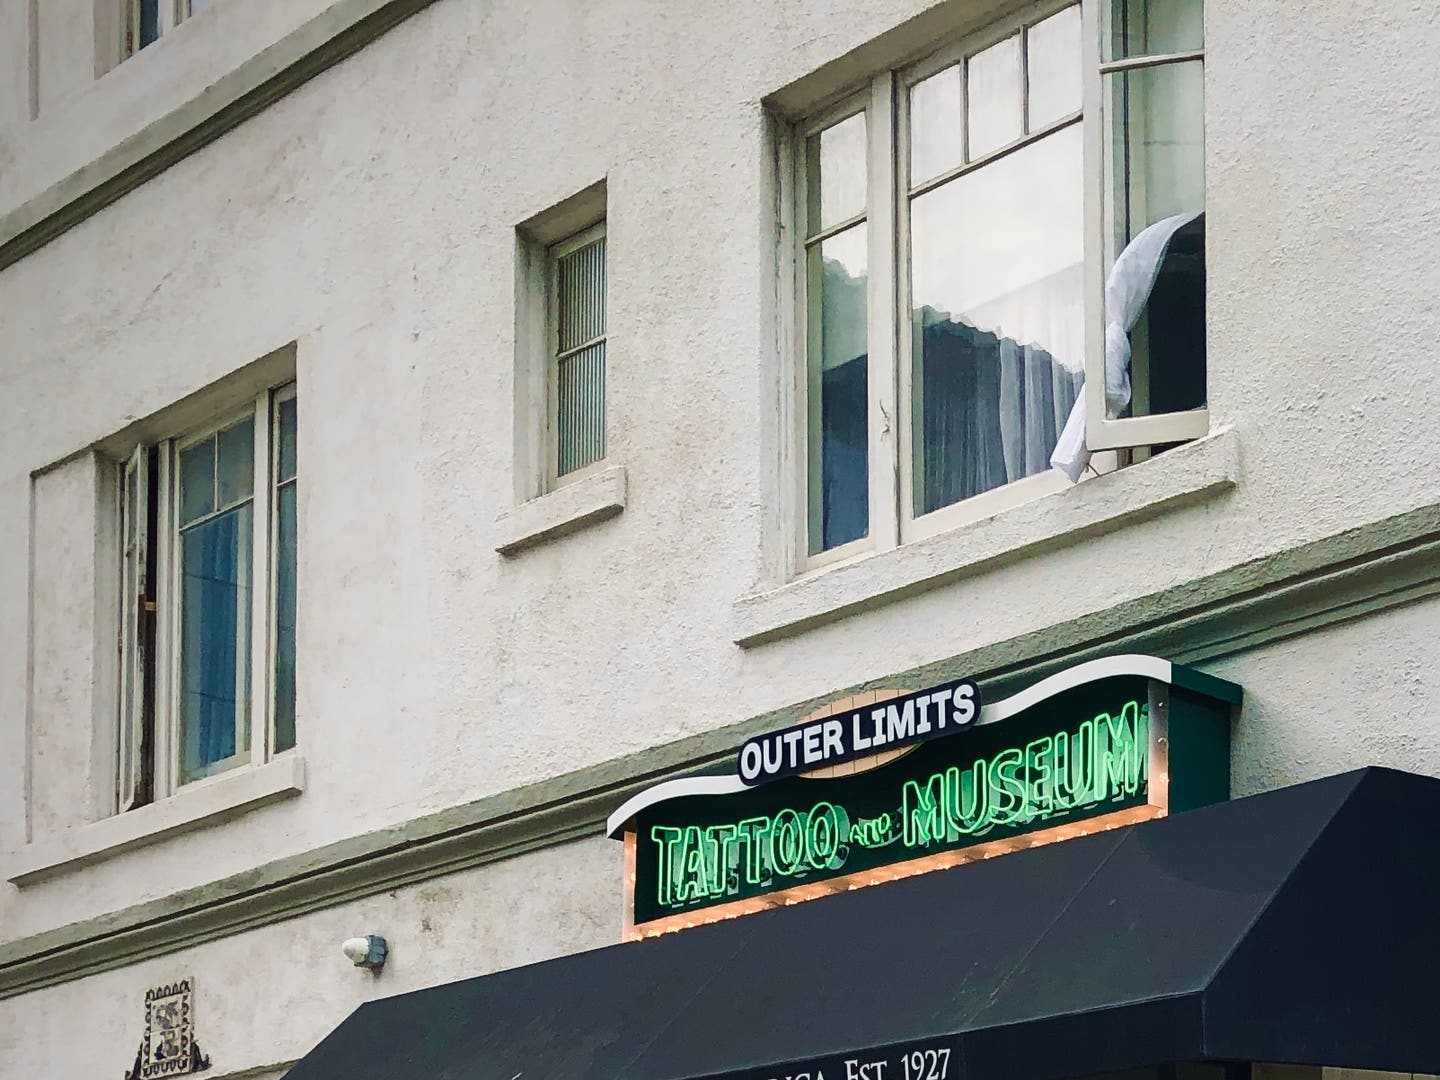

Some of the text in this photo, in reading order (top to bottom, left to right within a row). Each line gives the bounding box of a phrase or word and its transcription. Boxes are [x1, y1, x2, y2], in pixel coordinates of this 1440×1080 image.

[652, 801, 843, 905] TATTOO
[902, 700, 1142, 847] MUSEUM
[741, 684, 975, 779] OUTER LIMITS
